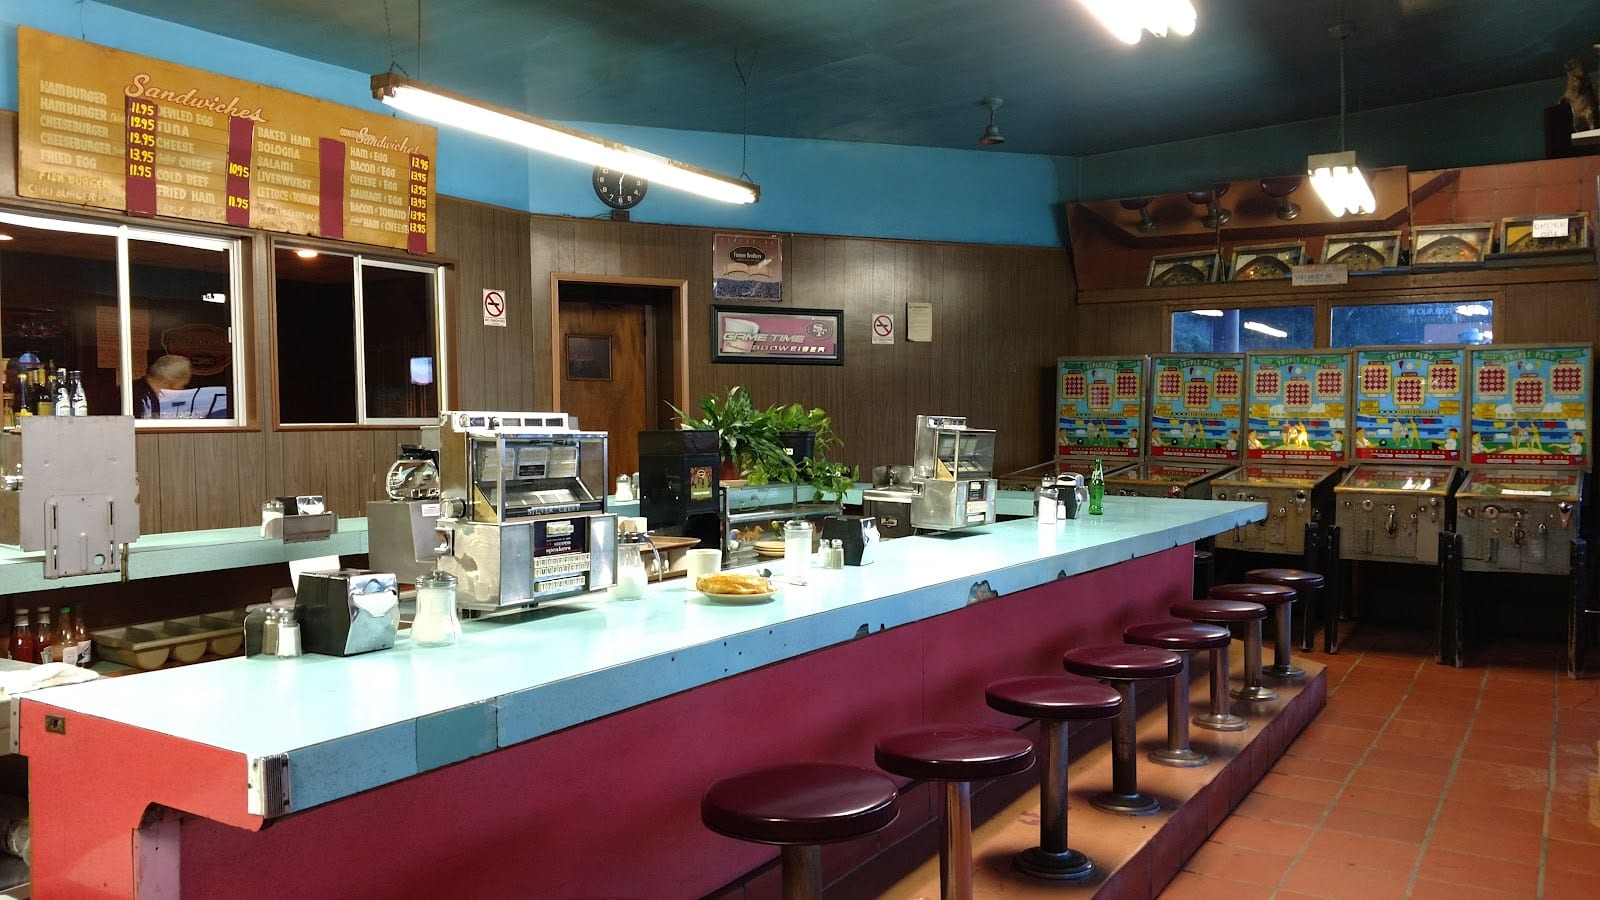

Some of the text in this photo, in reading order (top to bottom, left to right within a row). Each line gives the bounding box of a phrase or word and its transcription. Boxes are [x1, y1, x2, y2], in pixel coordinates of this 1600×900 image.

[40, 80, 107, 105] HAMBURGER
[124, 73, 266, 123] Sandwiches
[40, 97, 107, 121] HAMBURGER
[130, 102, 154, 120] 11.95
[40, 114, 109, 138] CHEESEBURGER
[130, 115, 155, 132] 12.95
[195, 114, 214, 127] EGG
[158, 122, 190, 137] TUNA
[257, 126, 311, 148] BAKED HAM
[40, 131, 112, 154] CHEESEBURGER
[129, 131, 155, 148] 12.95
[157, 137, 194, 153] CHEESE
[355, 127, 420, 155] Sandwiches
[129, 148, 154, 163] 13.95
[257, 141, 301, 160] BOLOGNA
[351, 146, 368, 159] HAM
[373, 151, 388, 164] EGG
[40, 149, 96, 170] FRIED EGG
[179, 156, 212, 173] CHEESE
[257, 156, 293, 173] SALAMI
[411, 156, 429, 171] 13.95
[129, 163, 152, 178] 11.95
[350, 159, 376, 175] BACON
[381, 166, 396, 179] EGG
[410, 170, 427, 183] 13.95
[157, 169, 209, 188] COLD BEEF
[257, 170, 312, 190] LIVERWURST
[350, 173, 377, 188] CHEESE
[156, 184, 215, 205] FRIED HAM
[257, 185, 289, 201] LETTUCE
[350, 187, 383, 203] SAUSAGE
[410, 184, 427, 197] 13.95
[350, 201, 374, 215] BACON
[379, 206, 407, 220] TOMATO
[410, 196, 427, 209] 13.95
[410, 210, 426, 222] 13.95
[363, 217, 380, 230] HAM
[384, 221, 409, 235] CHEESE
[409, 222, 426, 234] 13.95
[722, 331, 806, 343] GAME TIME
[751, 344, 826, 353] BUDWEISER
